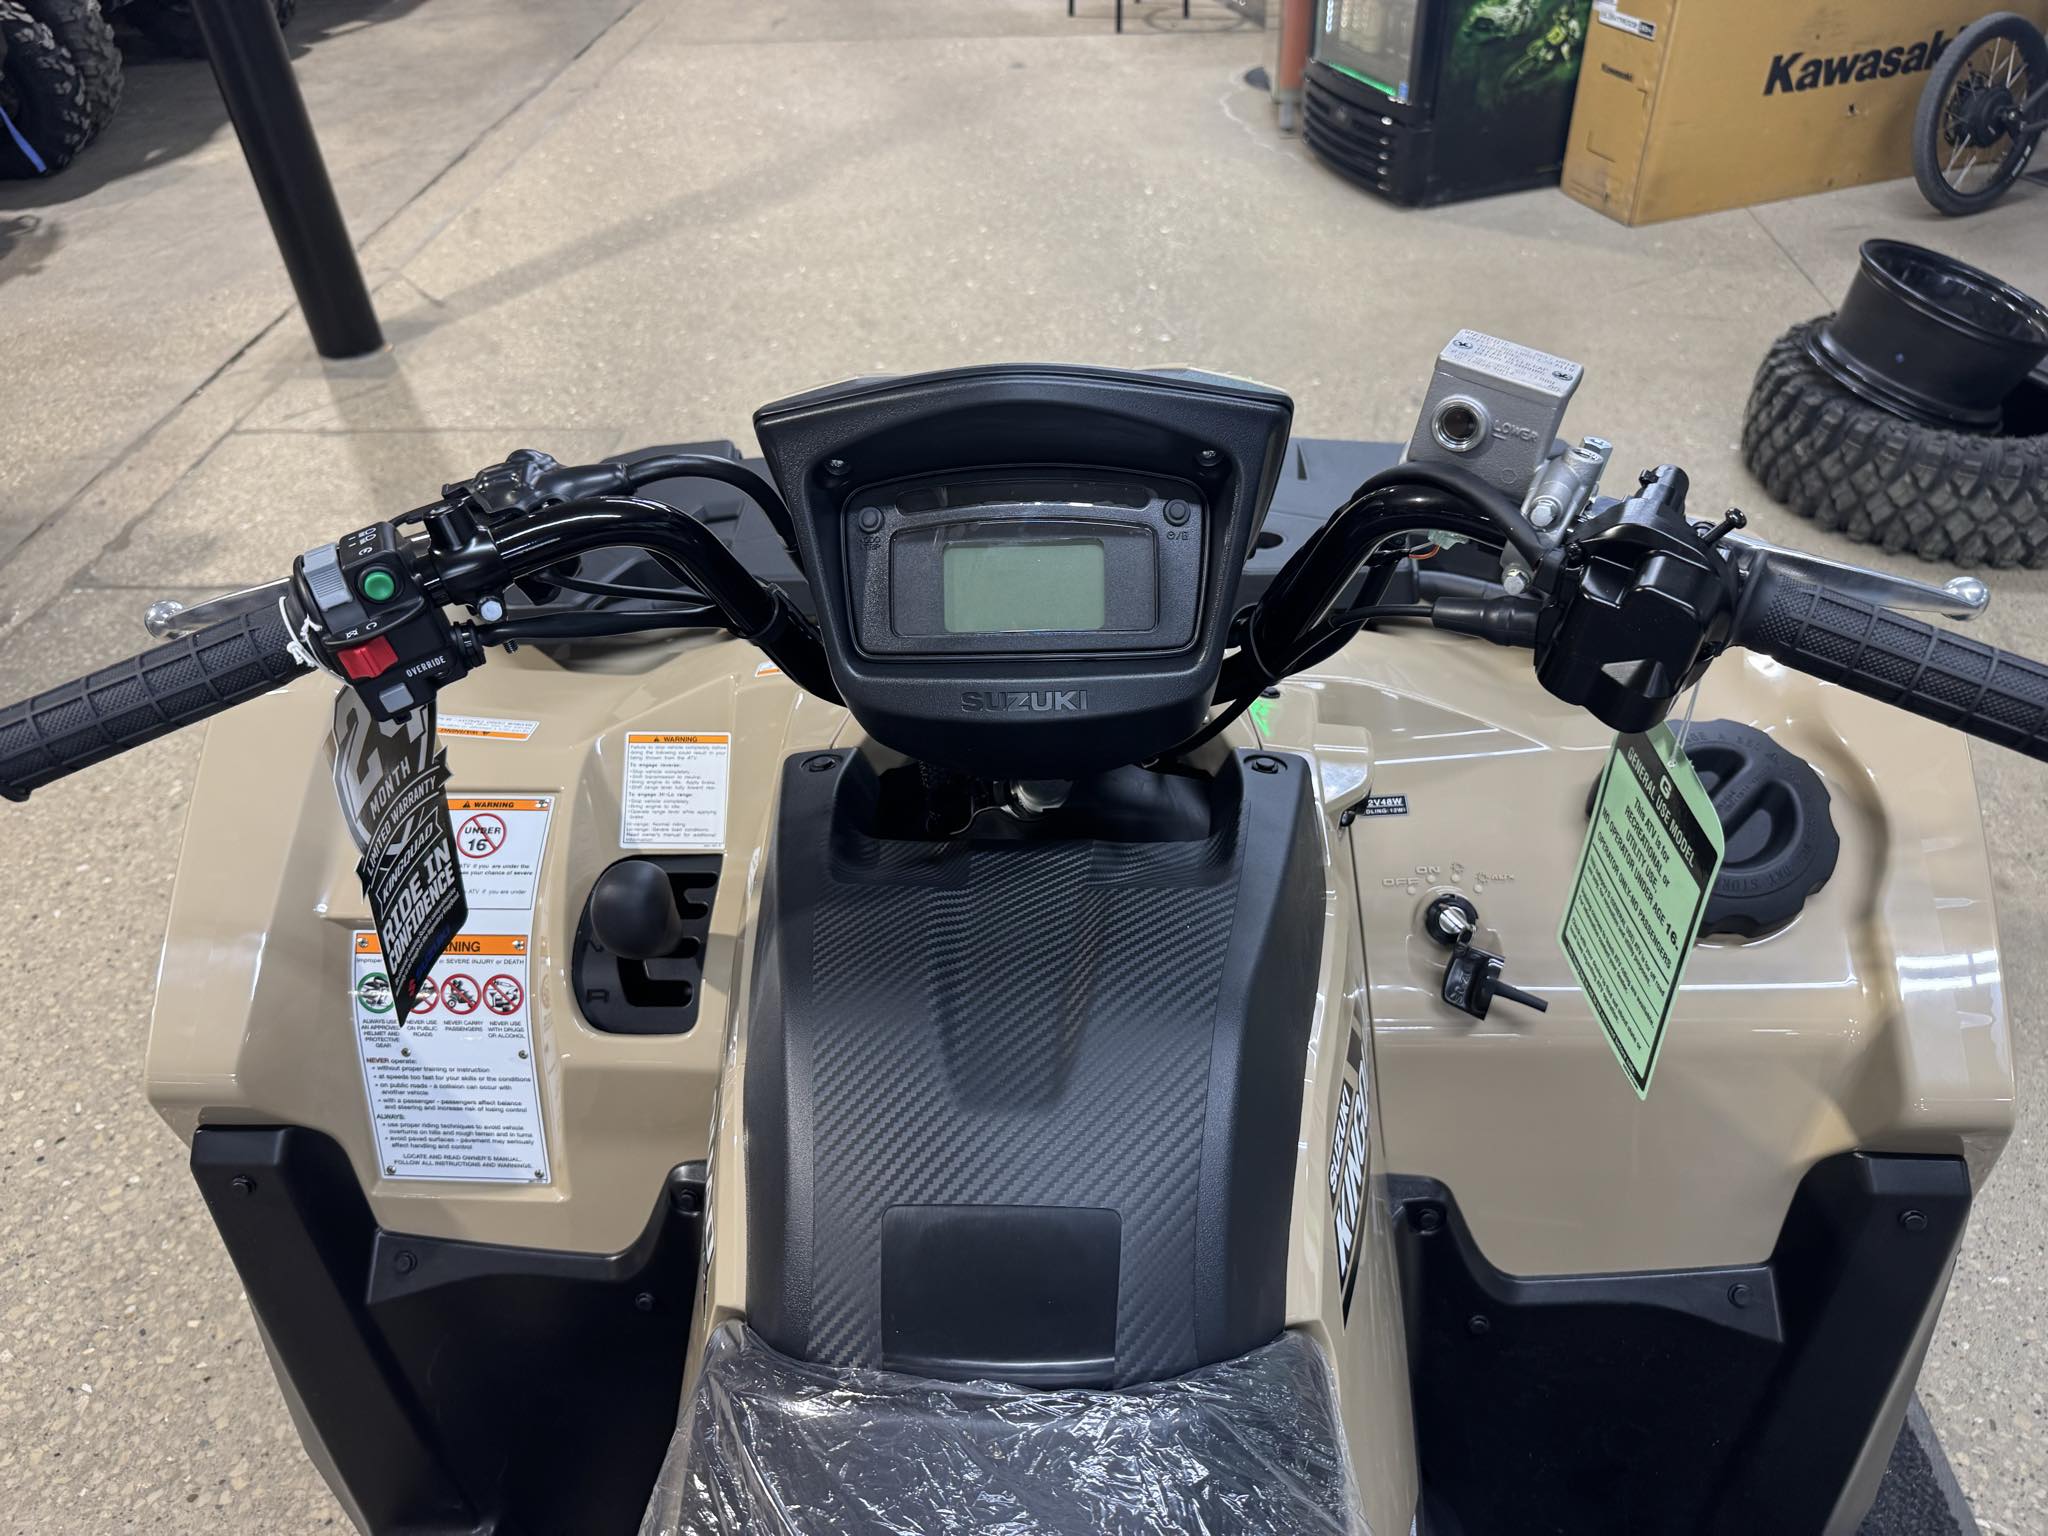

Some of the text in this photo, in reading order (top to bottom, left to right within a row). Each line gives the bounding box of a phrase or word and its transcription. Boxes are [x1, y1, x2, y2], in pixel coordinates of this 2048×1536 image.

[1763, 25, 1969, 96] Kawasak
[1493, 418, 1539, 443] LOWER
[406, 655, 446, 677] OVERRIDE
[960, 690, 1089, 713] SUZUKI
[370, 755, 411, 820] MONTH
[1368, 797, 1402, 807] 2V48W
[1627, 747, 1695, 868] GENERAL USE MODEL
[1659, 775, 1672, 799] G
[367, 775, 436, 877] LIMITED WARRANTY
[464, 826, 501, 834] UNDER
[468, 838, 487, 851] 16
[1625, 804, 1670, 887] RECREATIONAL or
[1634, 796, 1670, 863] This ATV is for
[381, 822, 433, 903] KINGQUAD
[1382, 877, 1420, 887] OFF
[1415, 865, 1441, 874] ON
[1602, 806, 1679, 951] NO OPERATOR UNDER AGE 16.
[1626, 829, 1658, 893] UTILITY USE,
[382, 872, 424, 955] RIDE
[423, 838, 453, 885] IN
[389, 860, 455, 976] CONFIDENCE
[1598, 830, 1671, 969] OPERATOR ONLY-NO PASSENGERS
[446, 941, 480, 952] NING
[587, 989, 609, 1003] R
[1331, 1084, 1350, 1194] SUZUKI
[1336, 1045, 1369, 1277] KINGQ
